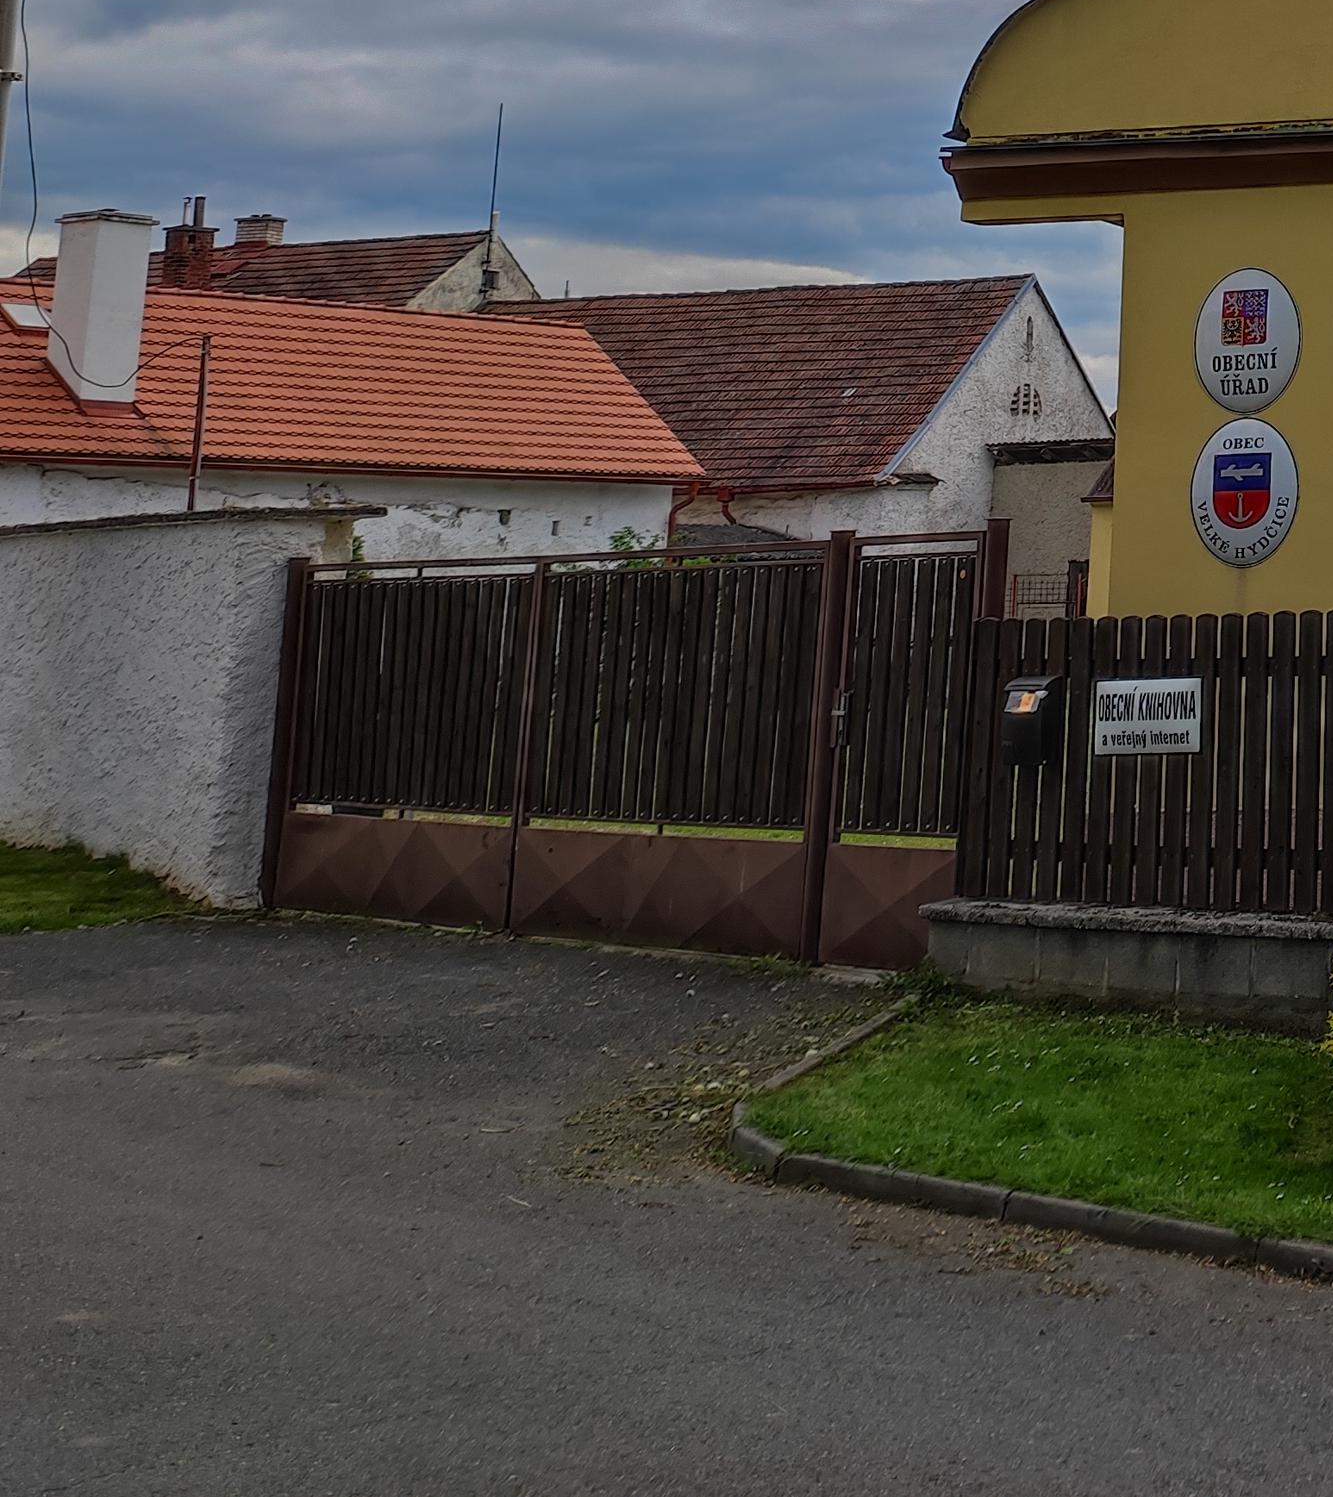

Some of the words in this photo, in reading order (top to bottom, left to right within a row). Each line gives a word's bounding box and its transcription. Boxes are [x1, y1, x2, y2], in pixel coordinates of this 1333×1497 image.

[1212, 347, 1278, 373] OBECNÍ
[1220, 373, 1269, 396] ÚŘAD
[1222, 437, 1265, 450] OBEC
[1197, 501, 1230, 554] VELKÉ
[1234, 496, 1290, 559] HYDČICE
[1099, 686, 1137, 722] OBECNÍ
[1137, 690, 1197, 721] KNIHOVNA
[1102, 734, 1108, 746] a
[1110, 730, 1147, 749] veřejný
[1149, 730, 1190, 746] internet
